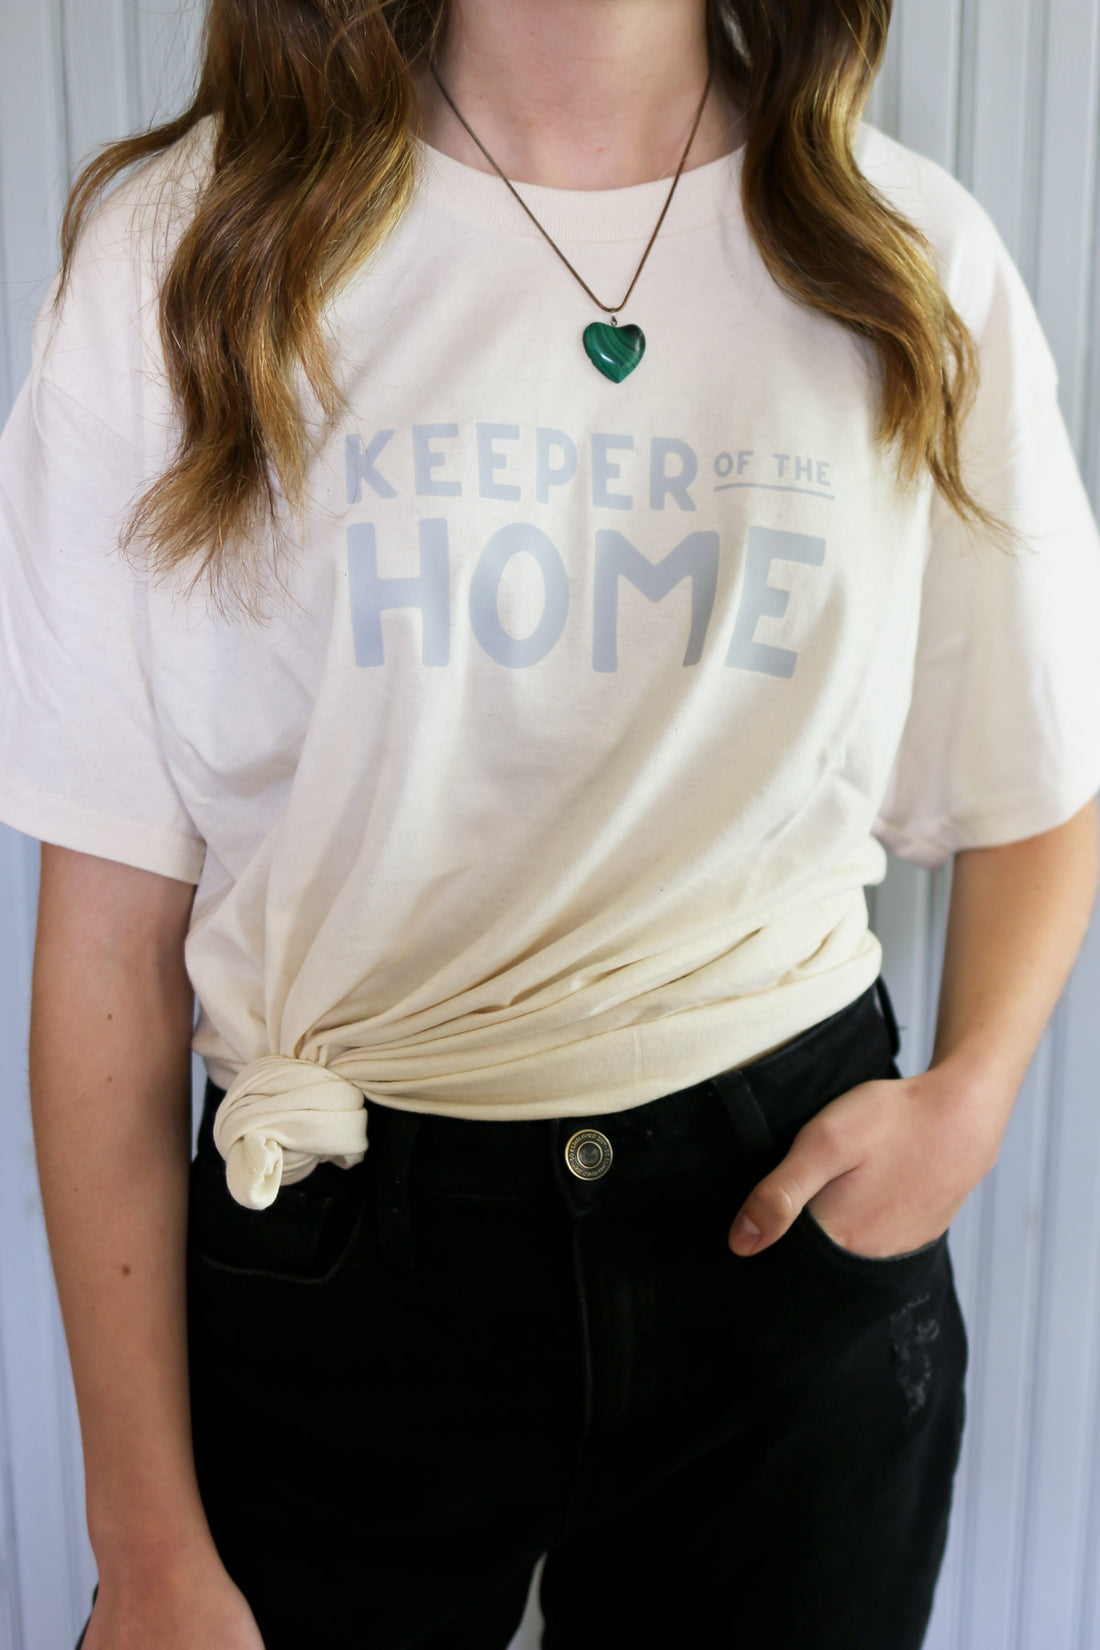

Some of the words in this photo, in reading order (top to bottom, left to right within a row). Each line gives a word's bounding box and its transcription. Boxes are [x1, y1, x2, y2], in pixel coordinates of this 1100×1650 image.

[345, 422, 698, 512] KEEPER
[713, 450, 754, 478] OF
[772, 452, 831, 487] THE
[346, 518, 827, 680] HOME
